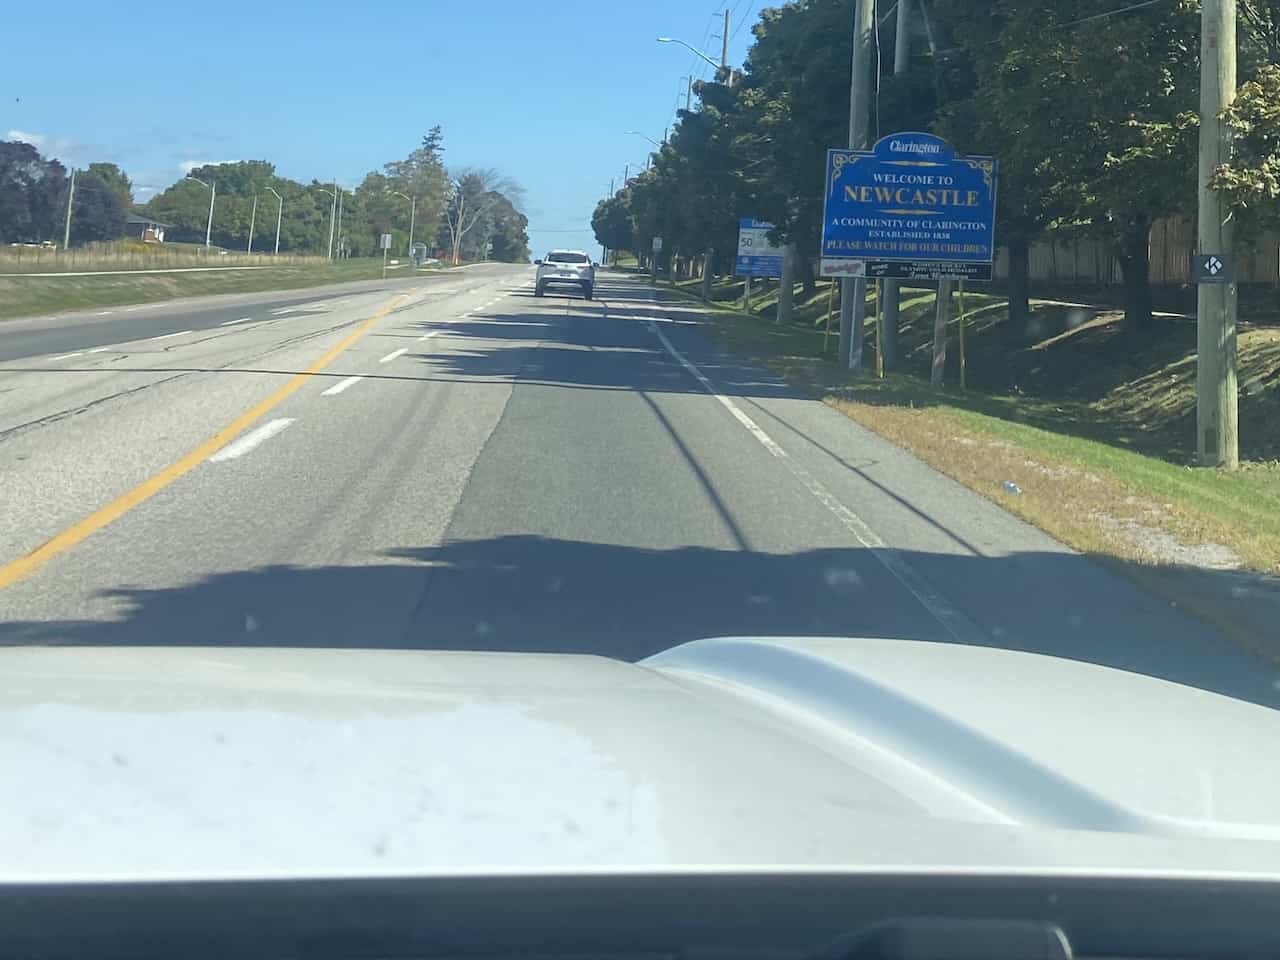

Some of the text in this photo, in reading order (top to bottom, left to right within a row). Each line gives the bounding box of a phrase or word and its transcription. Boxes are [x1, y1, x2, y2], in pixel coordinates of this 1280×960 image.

[889, 140, 940, 155] Clarington
[873, 174, 953, 186] WELCOME TO
[844, 186, 979, 206] NEWCASTLE
[832, 218, 987, 231] A COMMUNITY OF CLARINGTON
[869, 231, 930, 239] ESTABLISHED
[741, 237, 753, 248] 50
[827, 240, 863, 249] PLEASE
[864, 241, 897, 250] WATCH
[899, 242, 918, 251] FOR
[919, 243, 939, 251] OUR
